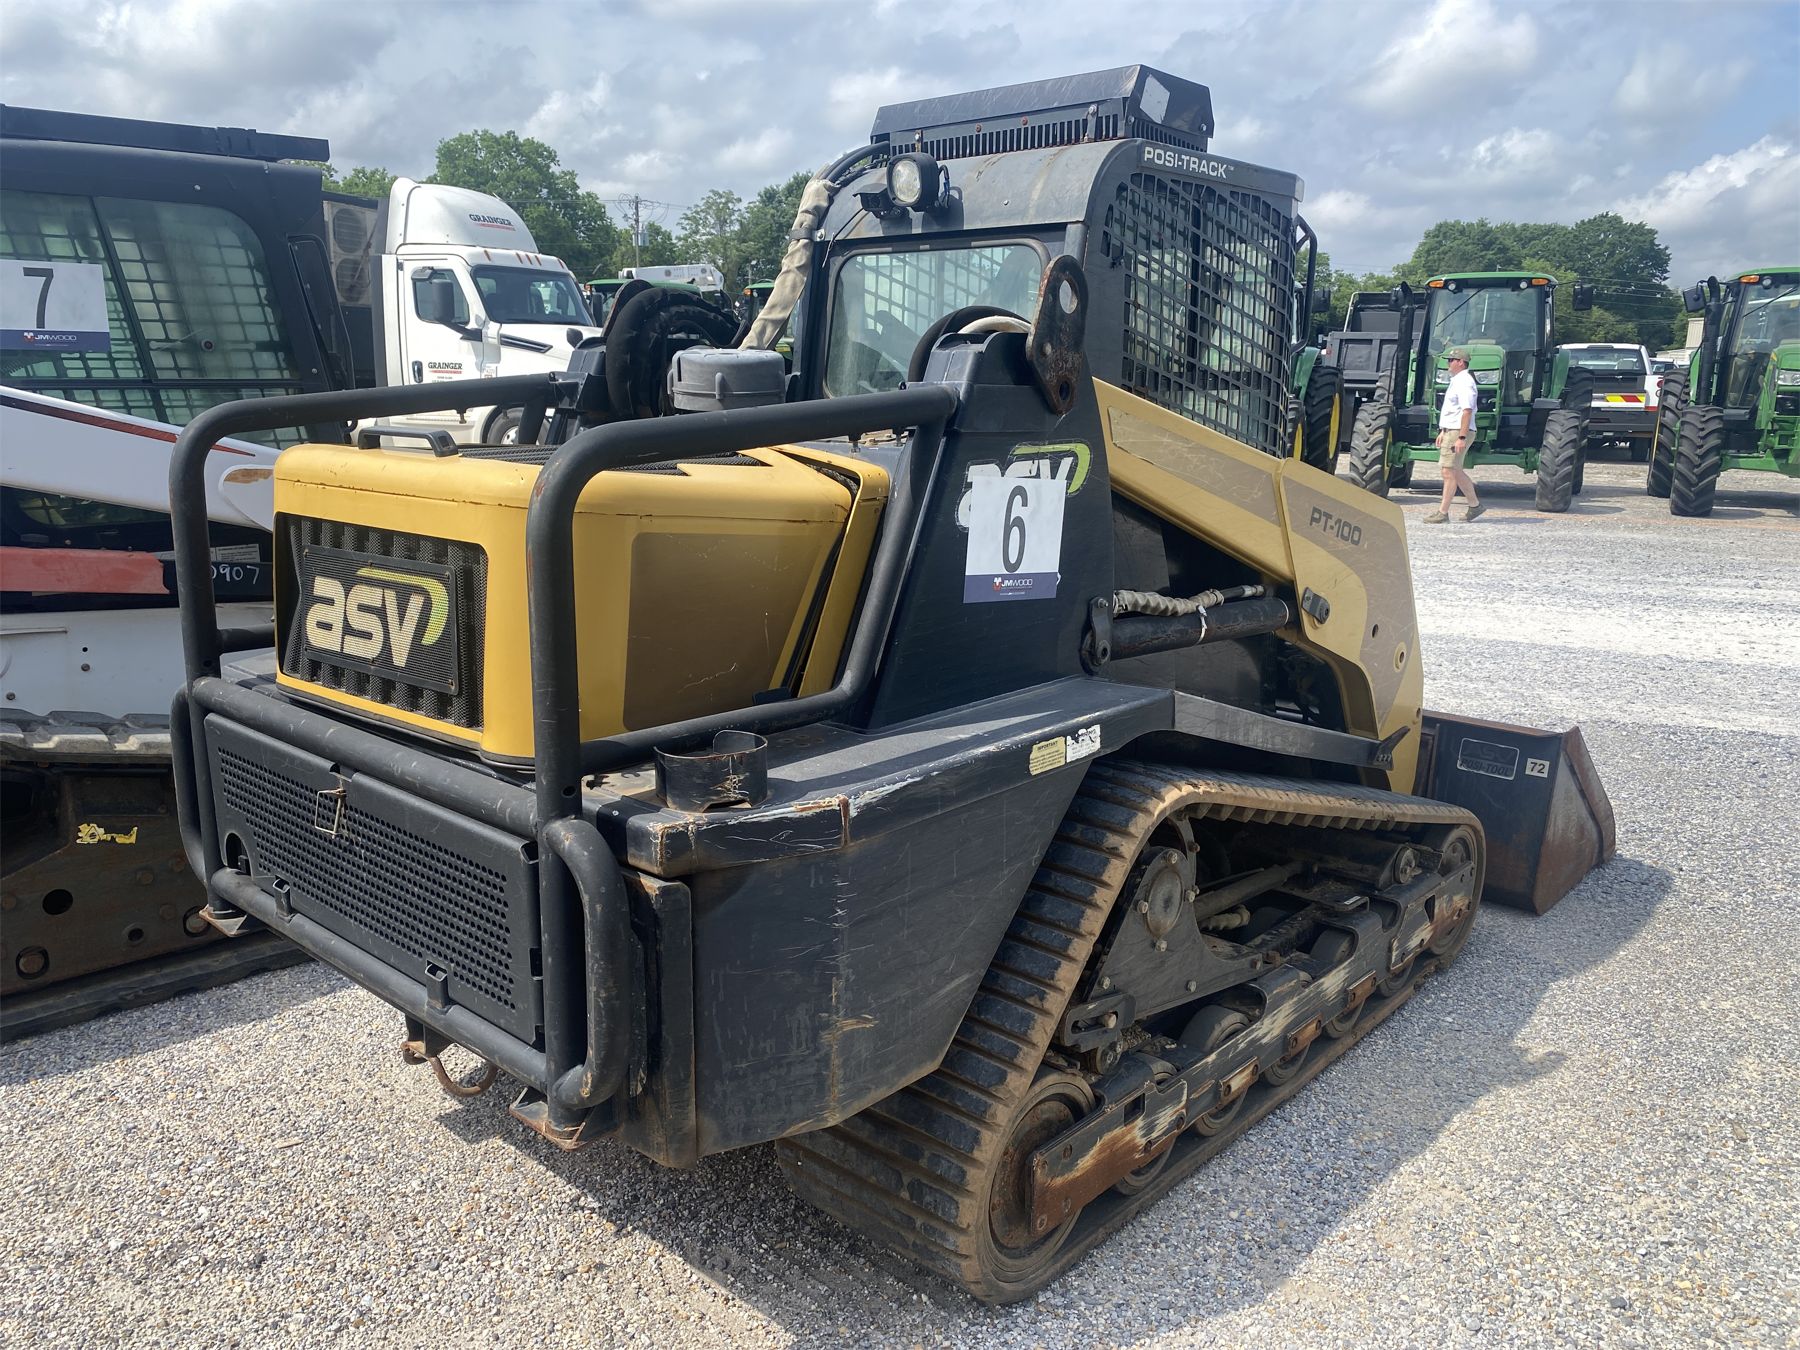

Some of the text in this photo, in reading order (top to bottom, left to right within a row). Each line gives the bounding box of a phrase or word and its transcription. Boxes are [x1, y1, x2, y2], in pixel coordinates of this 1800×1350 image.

[22, 266, 54, 330] 7
[428, 361, 463, 370] GRAINGER
[1002, 484, 1029, 574] 6
[1309, 504, 1362, 546] PT-100
[1530, 761, 1546, 774] 72
